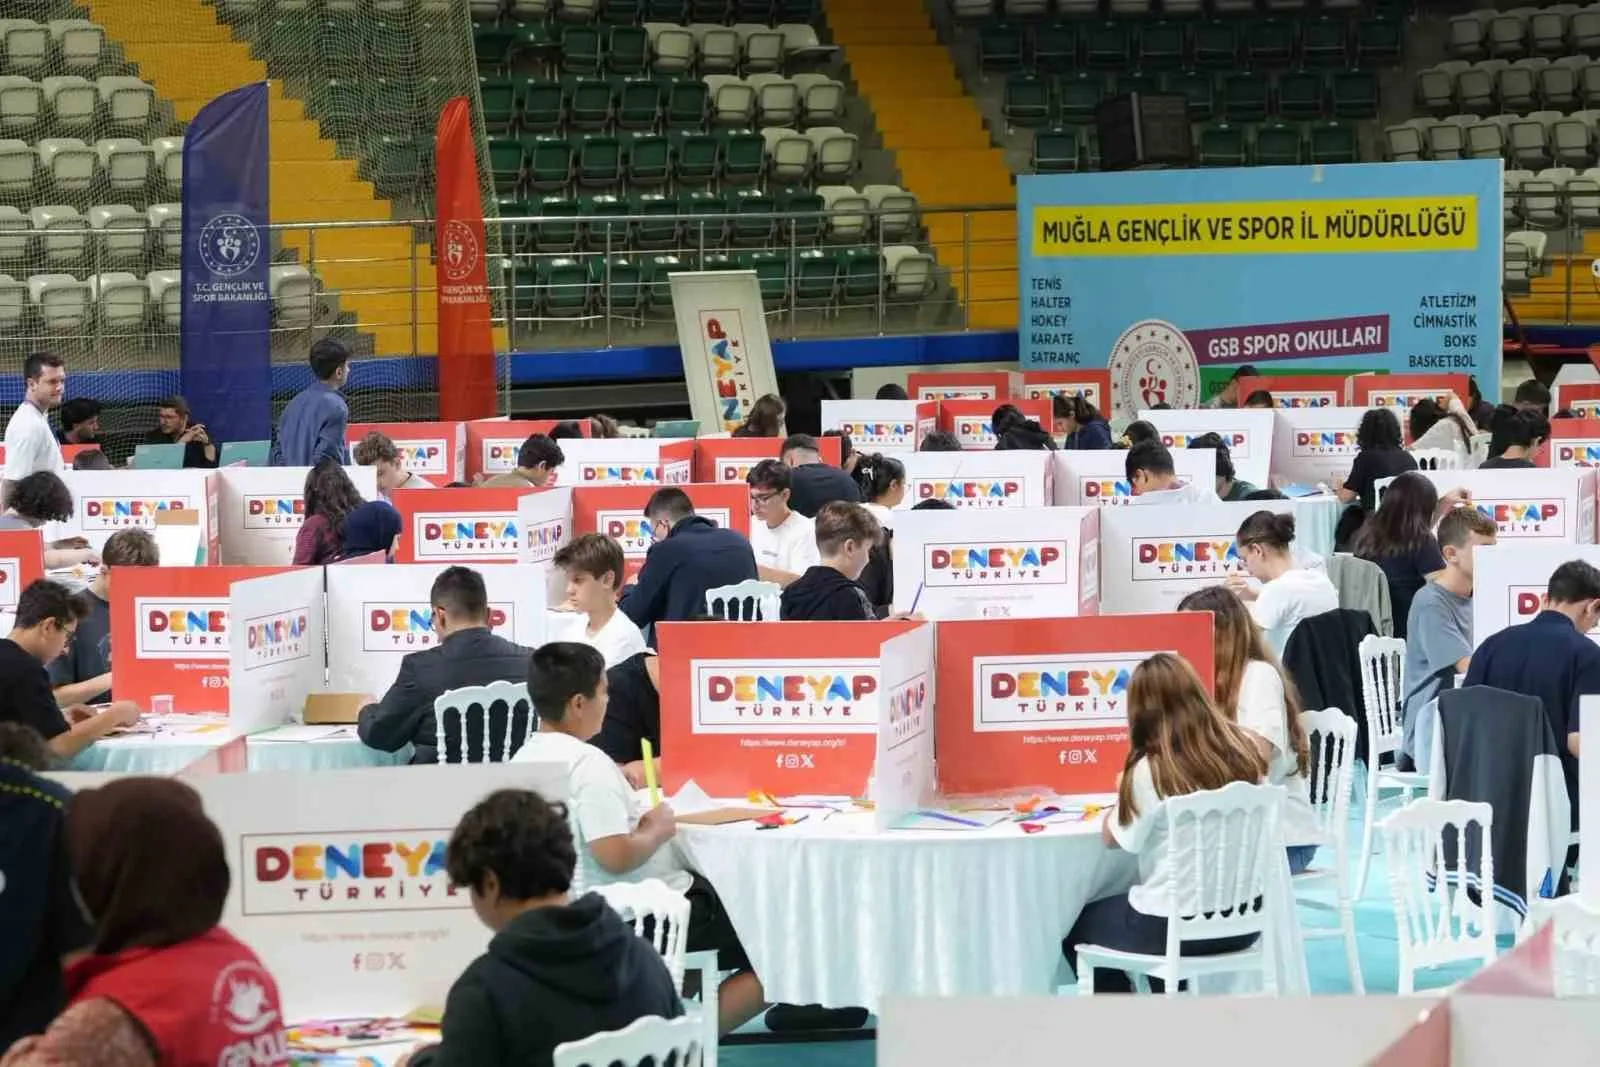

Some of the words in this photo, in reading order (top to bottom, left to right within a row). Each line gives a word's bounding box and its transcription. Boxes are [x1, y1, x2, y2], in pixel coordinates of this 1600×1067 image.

[1043, 216, 1111, 243] MUĞLA
[1117, 214, 1201, 245] GENÇLİK
[1208, 218, 1232, 240] VE
[1239, 216, 1294, 240] SPOR
[1301, 210, 1318, 239] İL
[1325, 206, 1466, 239] MÜDÜRLÜĞÜ
[1031, 297, 1071, 309] HALTER
[1420, 293, 1476, 308] ATLETİZM
[1031, 315, 1067, 327] HOKEY
[1031, 333, 1074, 345] KARATE
[1208, 337, 1240, 358] GSB
[1243, 333, 1290, 356] SPOR
[1294, 325, 1382, 351] OKULLARI
[1444, 335, 1477, 348] BOKS
[1031, 352, 1080, 366] SATRANÇ
[1409, 355, 1477, 368] BASKETBOL
[844, 424, 913, 436] DENEYAP
[919, 480, 1018, 498] DENEYAP
[932, 547, 1059, 569] DENEYAP
[952, 568, 1040, 580] TÜRKİYE
[248, 615, 306, 650] DENEYAP
[708, 675, 877, 702] DENEYAP
[735, 703, 852, 717] TÜRKİYE
